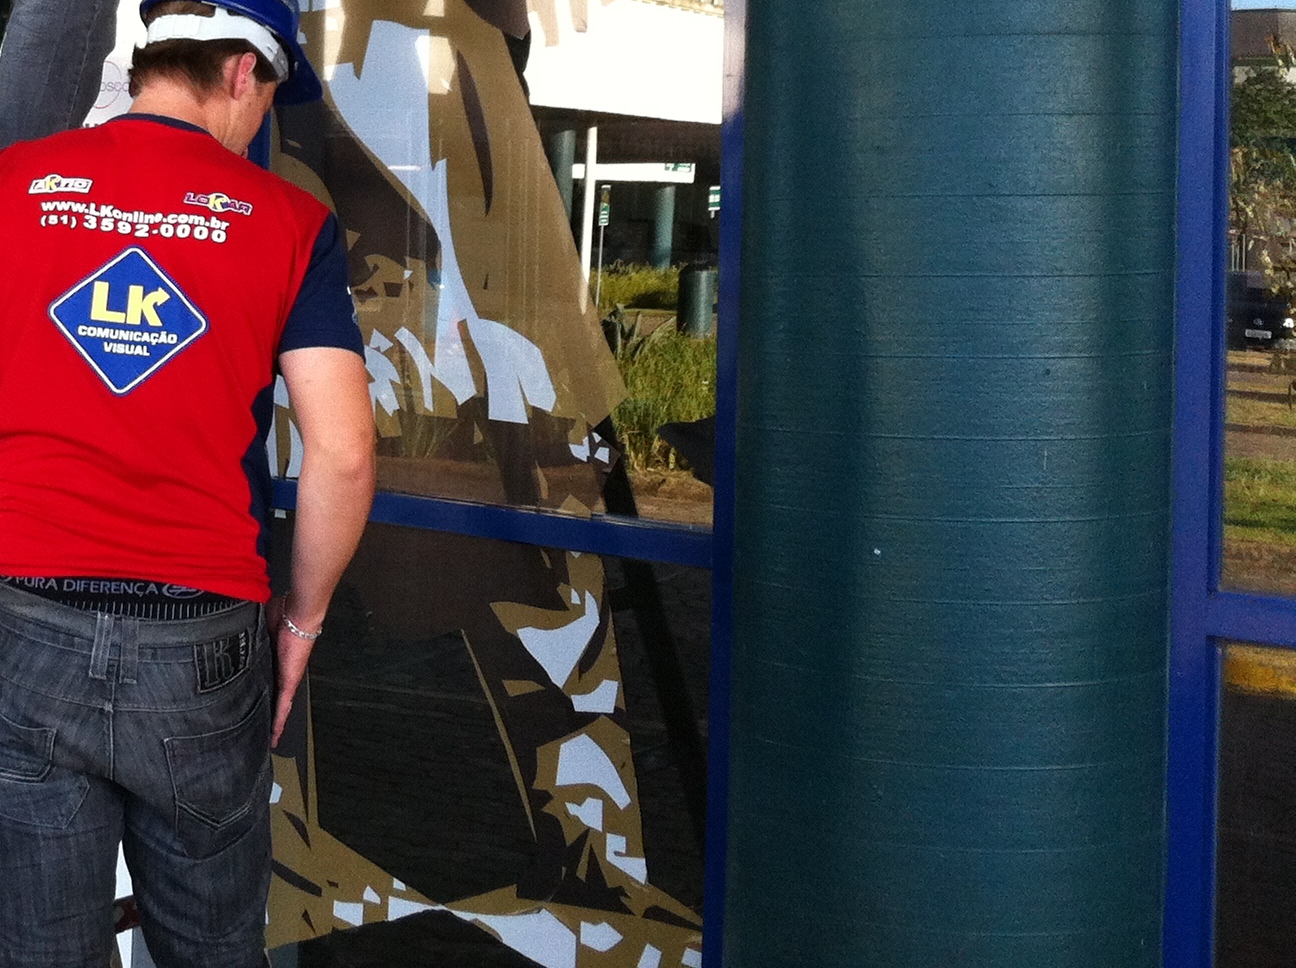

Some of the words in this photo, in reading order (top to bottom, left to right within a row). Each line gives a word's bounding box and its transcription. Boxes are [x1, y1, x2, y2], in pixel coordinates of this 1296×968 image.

[41, 202, 230, 231] www.LKonline.com.br
[40, 215, 77, 229] (51)
[83, 215, 227, 243] 3592-0000
[90, 280, 170, 327] LK
[77, 325, 178, 345] COMUNICAÇÃO
[103, 341, 150, 357] VISUAL
[63, 579, 159, 598] DIFERENÇA
